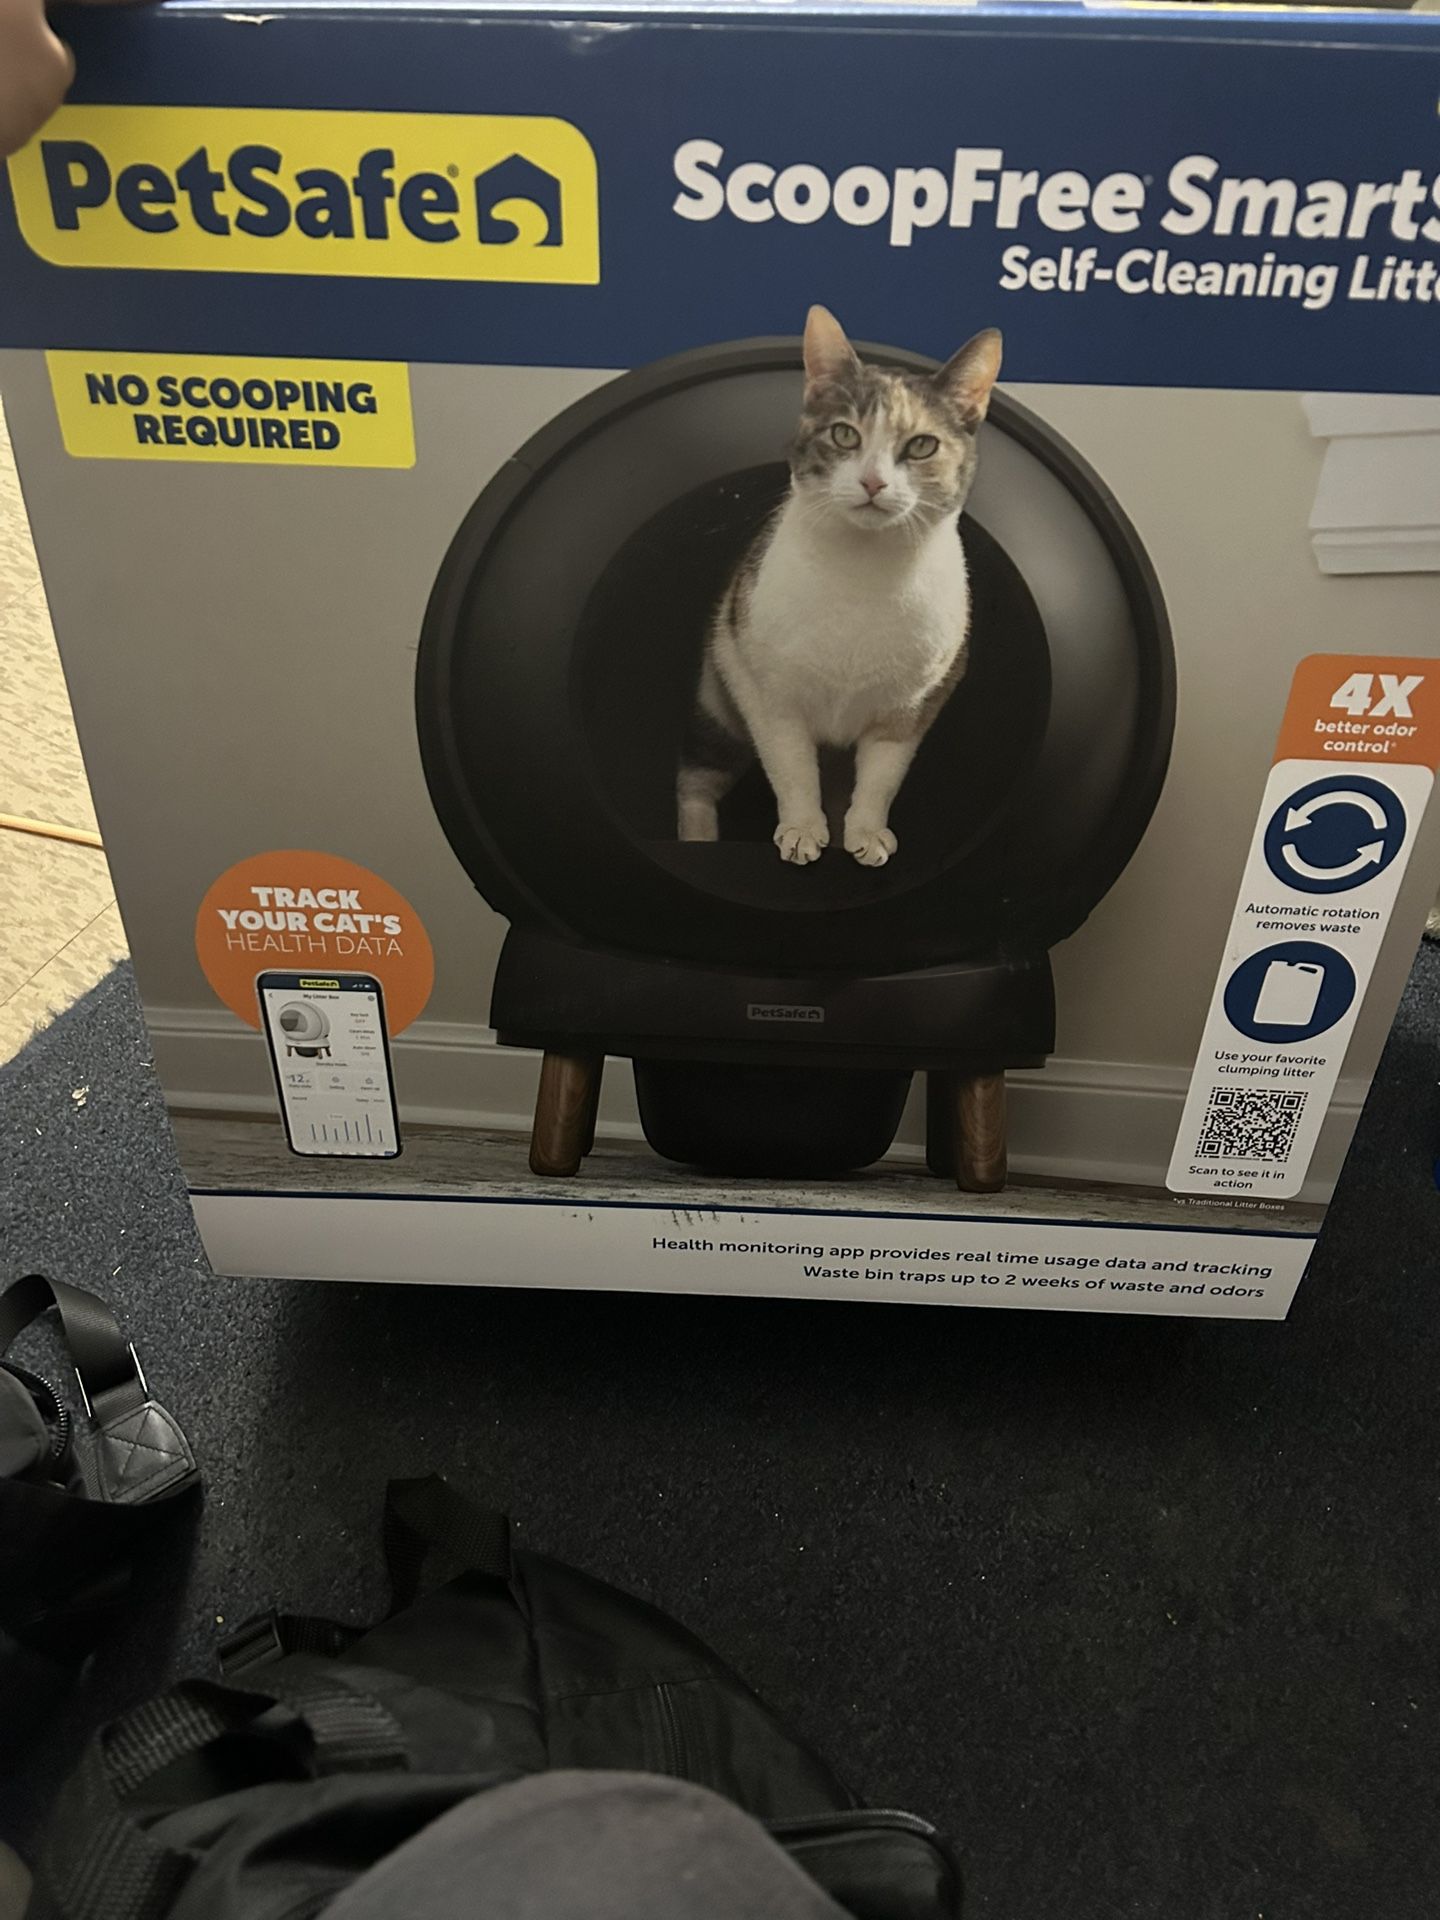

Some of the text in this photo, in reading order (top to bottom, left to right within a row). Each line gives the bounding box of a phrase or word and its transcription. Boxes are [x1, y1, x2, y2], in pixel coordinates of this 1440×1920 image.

[1000, 245, 1440, 310] Self-Cleaning Litt
[86, 373, 377, 414] NO SCOOPING
[134, 414, 341, 450] REQUIRED
[1330, 673, 1425, 718] 4X
[1314, 719, 1417, 737] better odor
[251, 886, 362, 911] TRACK
[217, 910, 402, 935] YOUR CAT'S
[1245, 903, 1380, 920] Automatic rotation
[1256, 920, 1361, 934] removes waste
[225, 933, 403, 956] HEALTH DATA
[1215, 1050, 1327, 1066] Use your favorite
[1218, 1065, 1316, 1078] clumping litter
[1188, 1165, 1286, 1180] Scan to see it in
[1213, 1180, 1253, 1189] action
[1188, 1198, 1233, 1207] Traditional
[1234, 1200, 1258, 1209] Litter
[1259, 1202, 1286, 1211] Boxes
[653, 1237, 1273, 1279] Health monitoring app provides real time usage data and tracking
[803, 1265, 1265, 1298] Waste bin traps up to 2 weeks of waste and odors
